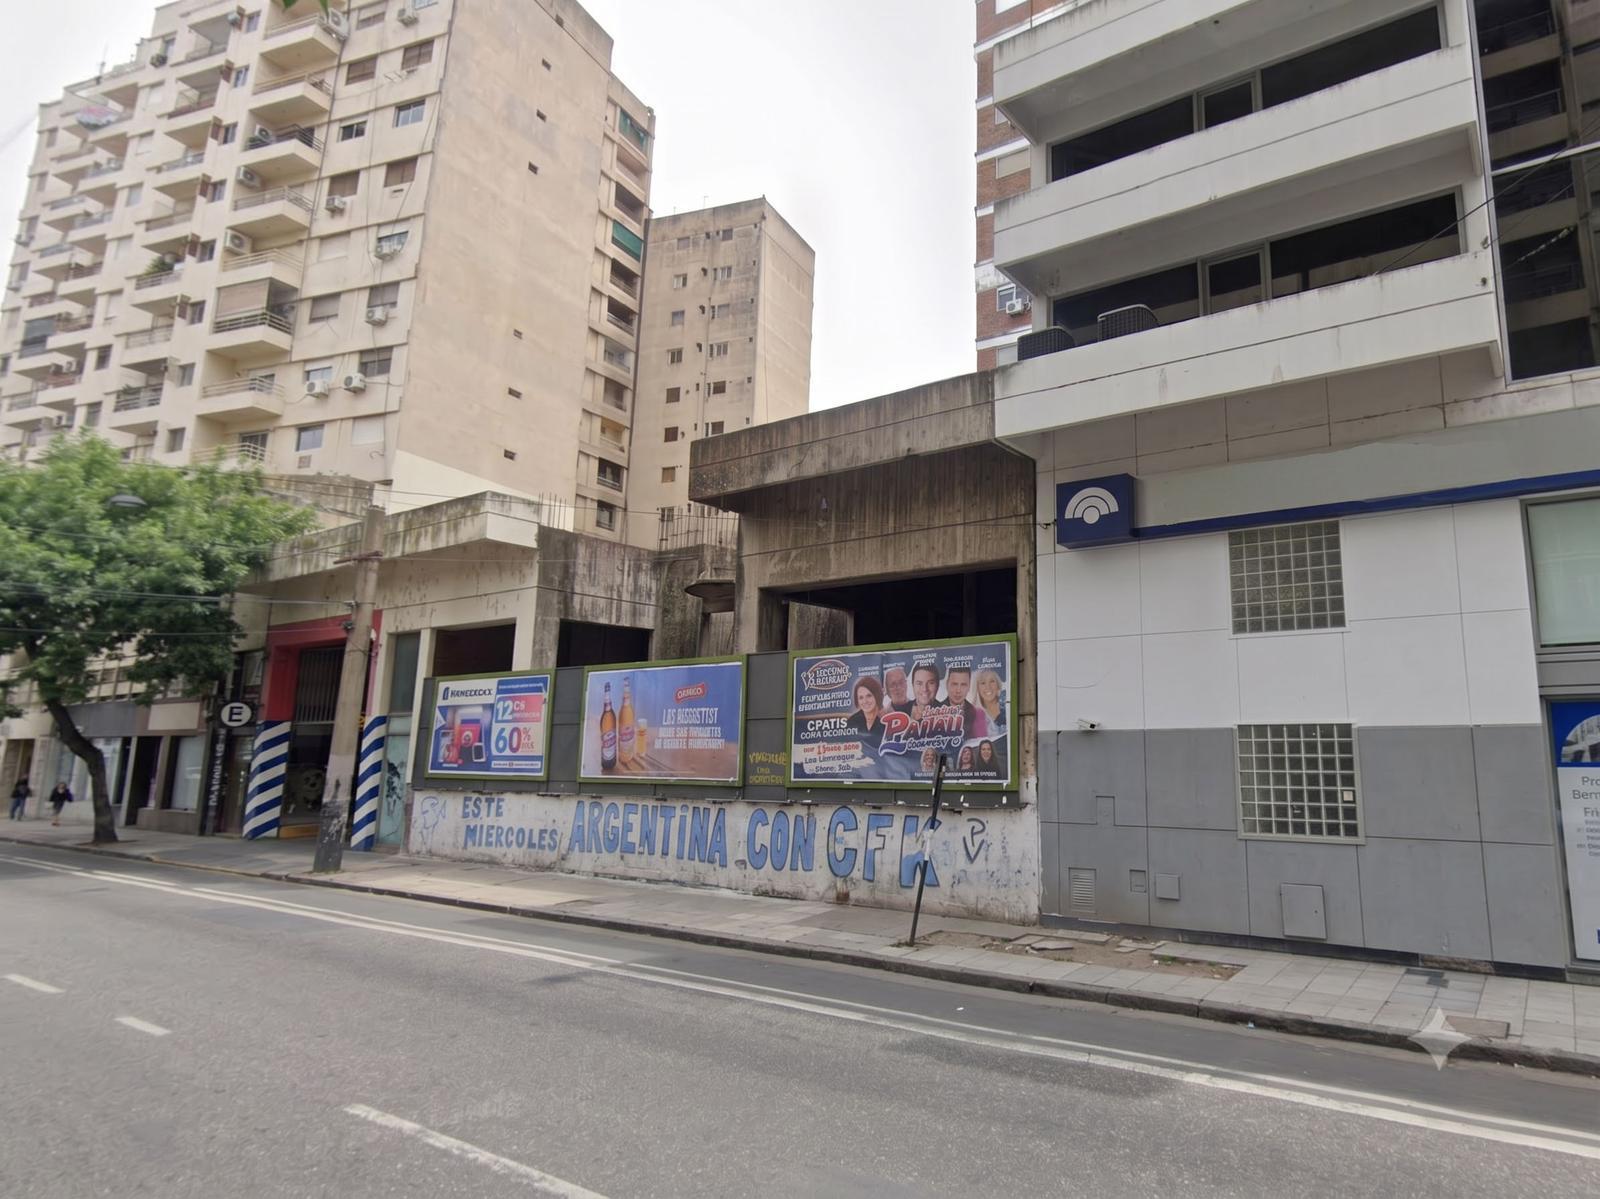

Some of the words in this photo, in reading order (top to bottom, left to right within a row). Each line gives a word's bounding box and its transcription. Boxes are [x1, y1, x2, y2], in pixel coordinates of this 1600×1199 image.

[228, 706, 244, 722] E
[462, 796, 505, 819] ESTE
[463, 824, 558, 852] MIERCOLES
[747, 807, 817, 871] CON
[827, 805, 942, 888] CFK
